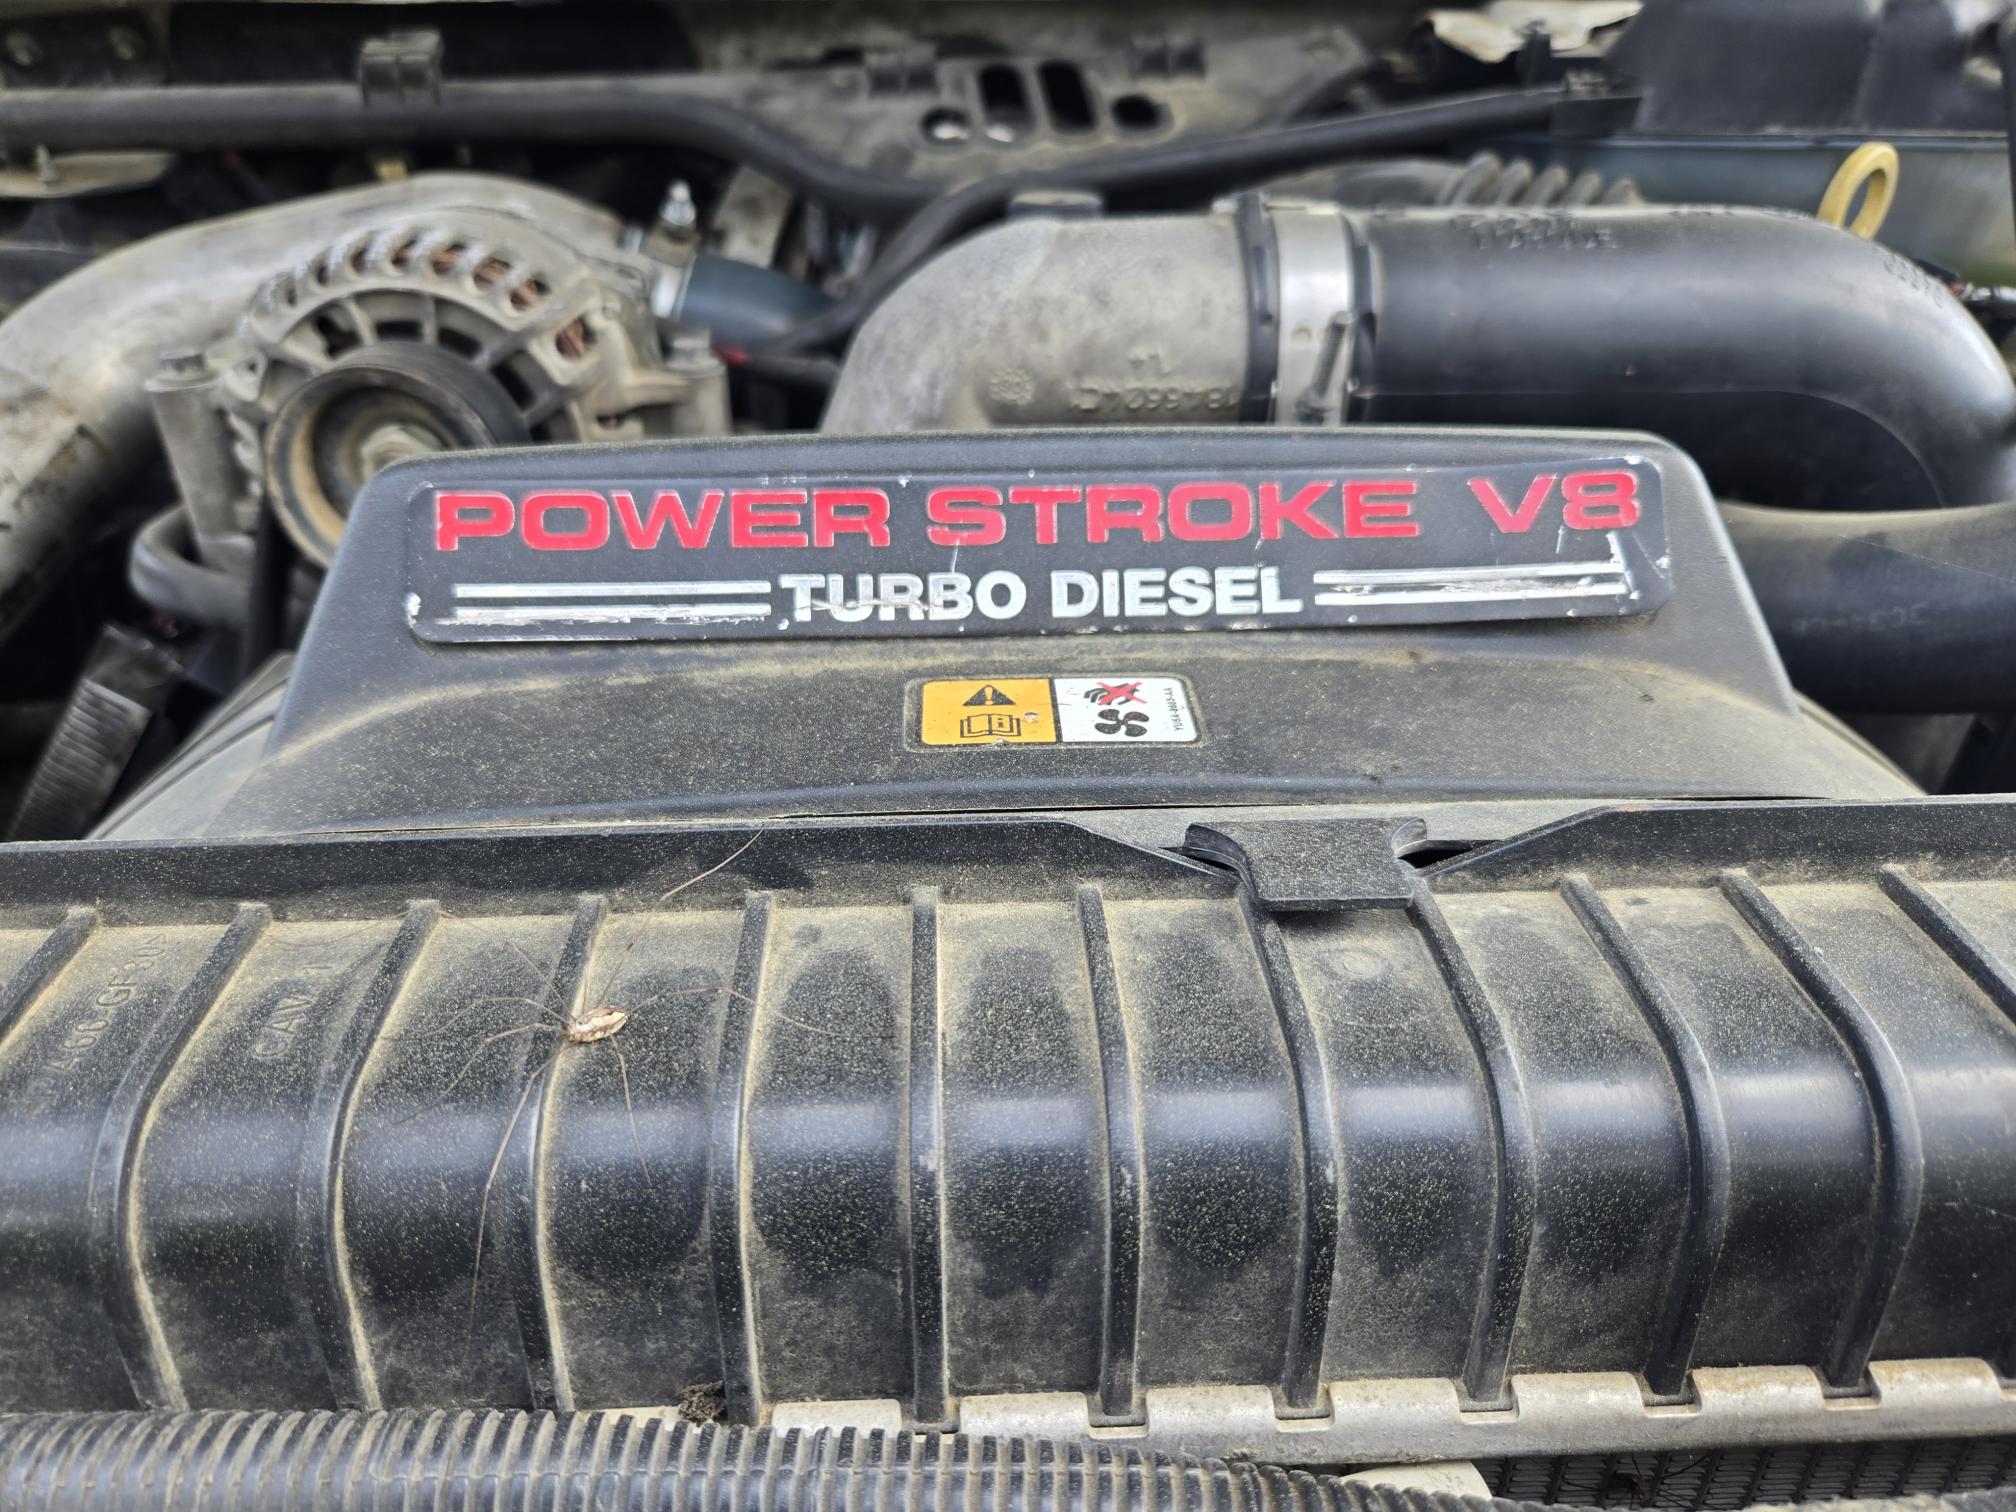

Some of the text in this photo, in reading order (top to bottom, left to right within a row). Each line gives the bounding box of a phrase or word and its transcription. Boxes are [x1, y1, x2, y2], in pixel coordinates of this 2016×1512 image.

[434, 469, 1640, 551] POWER STROKE V8
[779, 566, 1304, 622] TURBO DIESEL
[252, 994, 315, 1059] CAV
